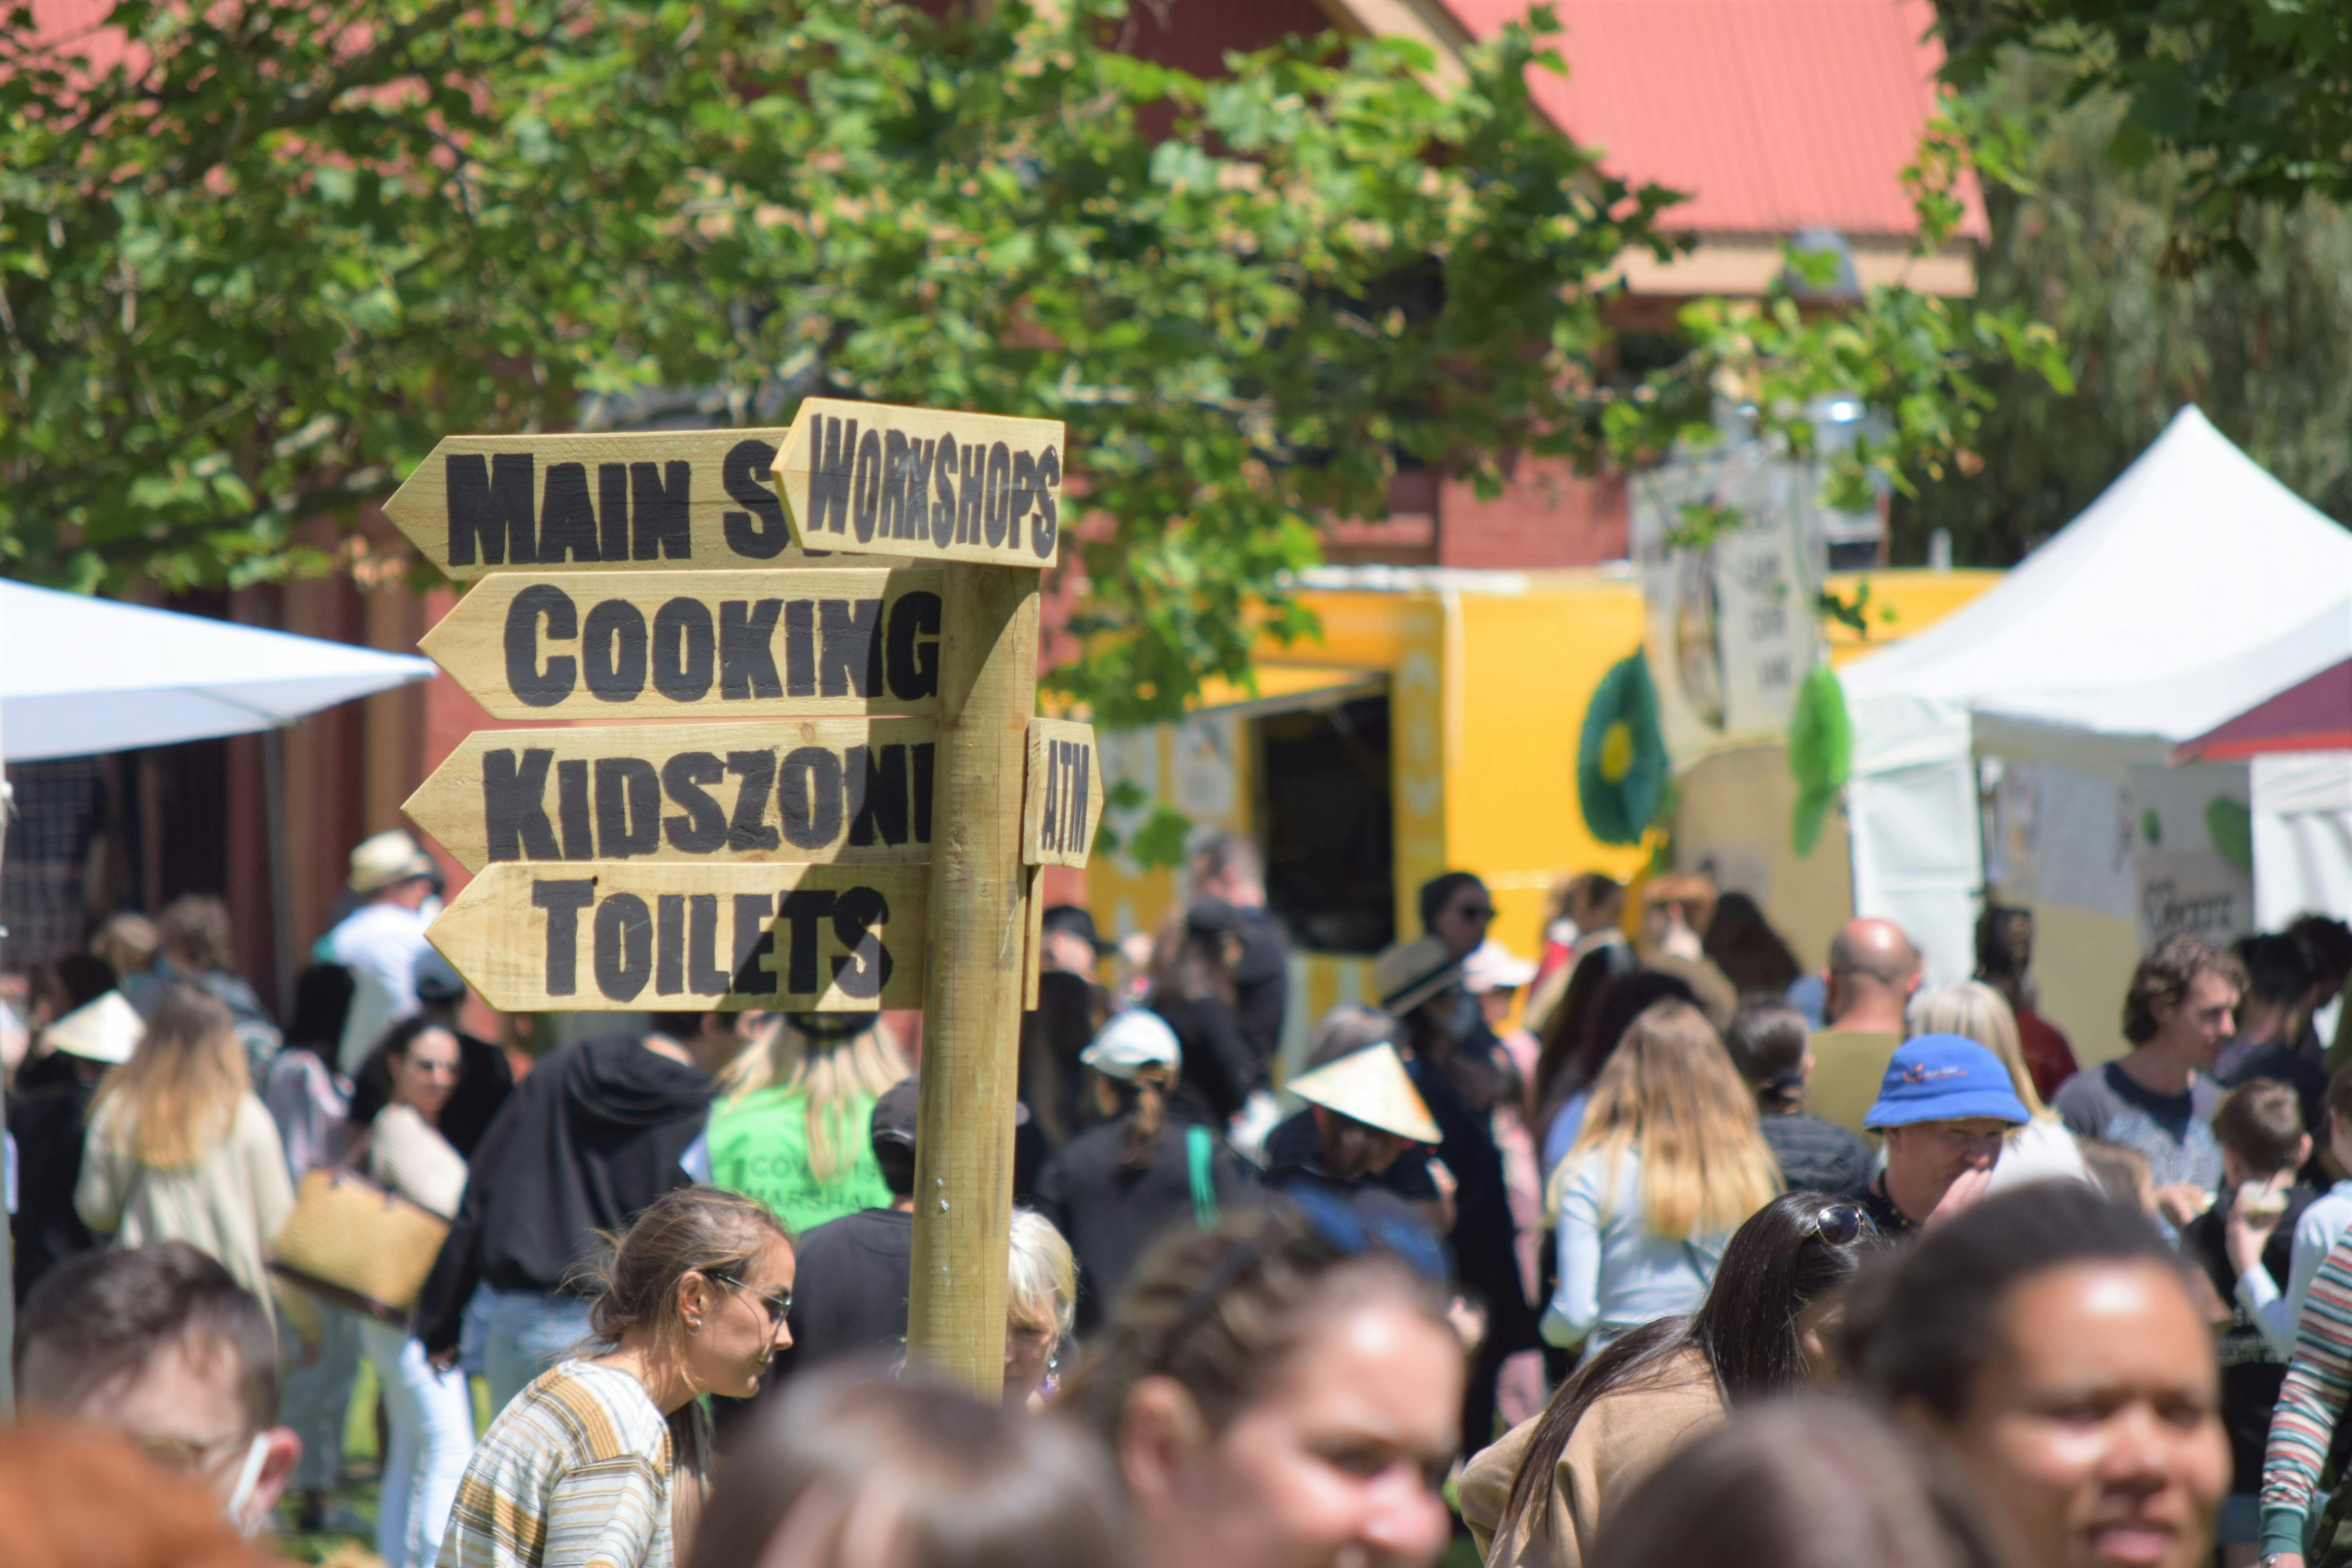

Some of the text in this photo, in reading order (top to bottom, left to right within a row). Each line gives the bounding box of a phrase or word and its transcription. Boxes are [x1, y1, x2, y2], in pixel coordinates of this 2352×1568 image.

[445, 453, 691, 566] MAIN
[808, 413, 1060, 559] WORKSHOPS
[504, 584, 942, 707] COOKING
[1042, 739, 1089, 853] ATM
[532, 880, 893, 1002] TOILETS
